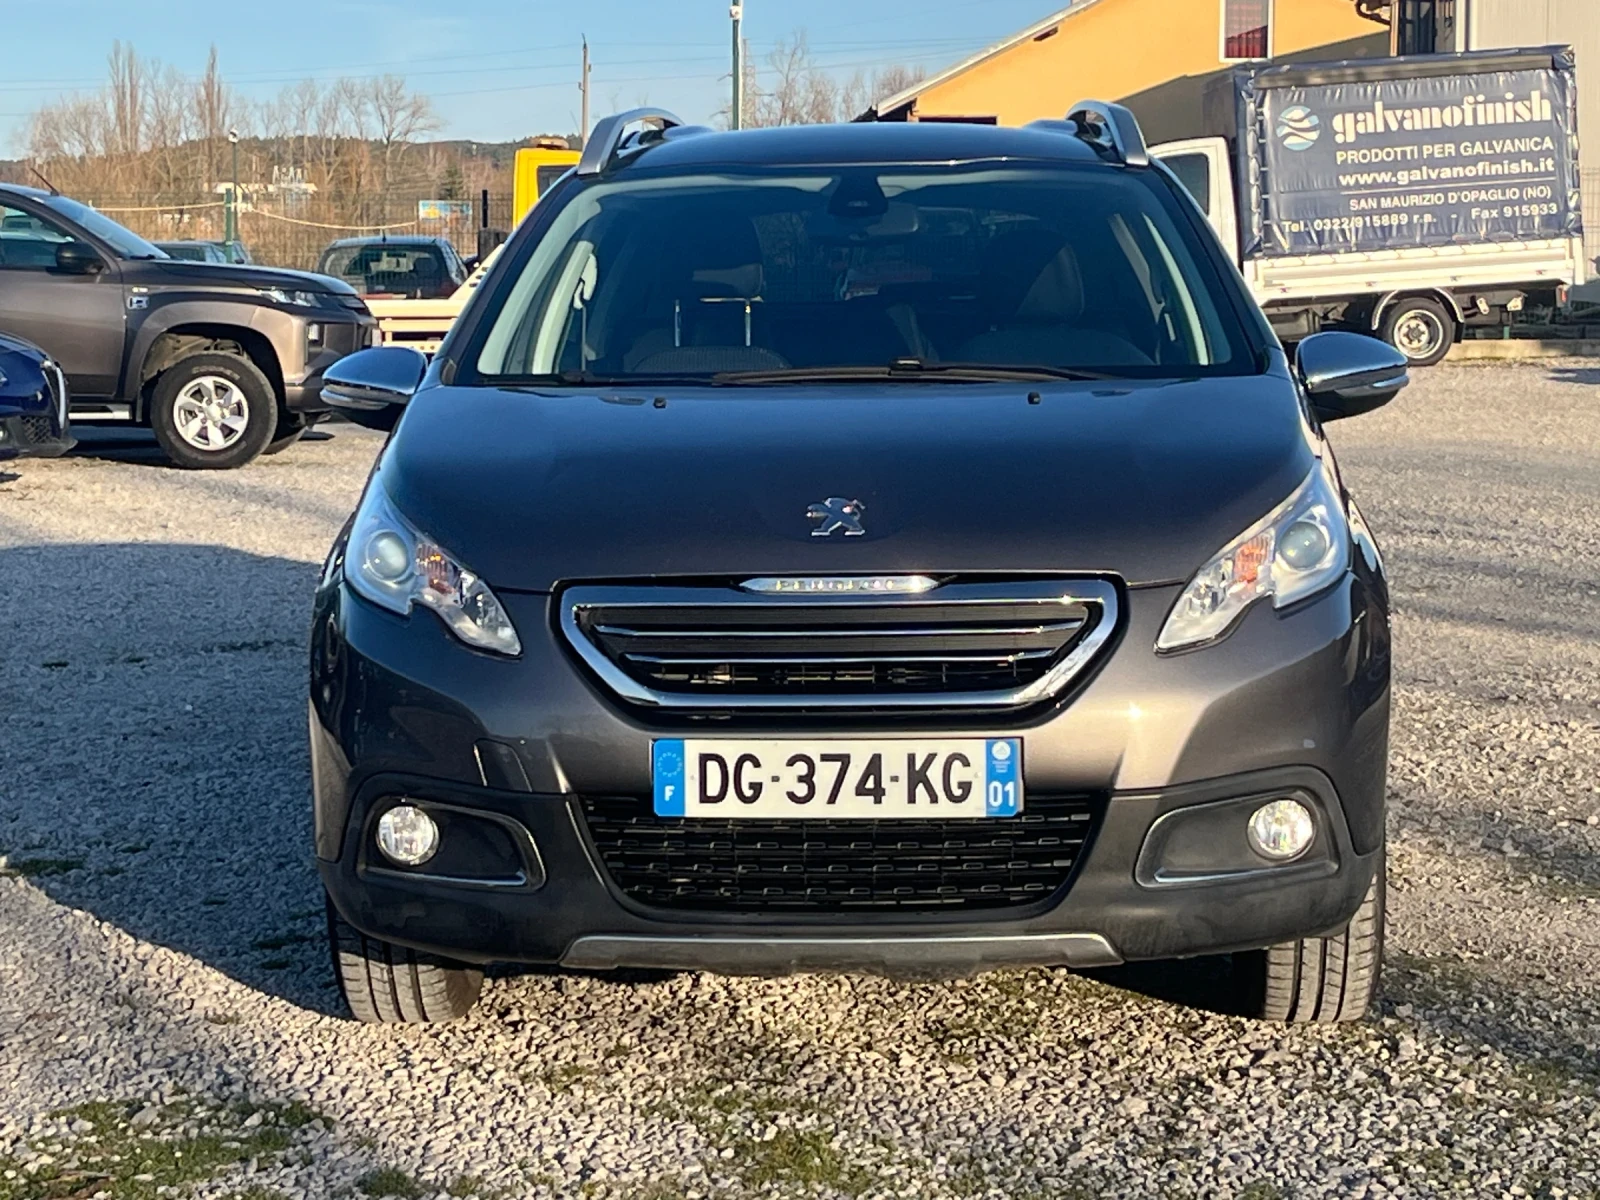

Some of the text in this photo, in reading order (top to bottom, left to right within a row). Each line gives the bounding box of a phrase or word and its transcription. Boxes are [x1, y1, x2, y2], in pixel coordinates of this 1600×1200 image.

[1332, 90, 1552, 143] galvanofinish
[1336, 136, 1554, 164] PRODOTTI PER GALVANICA
[1339, 157, 1555, 186] www.galvanofinish.it
[1350, 186, 1552, 210] SAN MAURIZIO D'OPAGLIO (NO)
[1282, 219, 1309, 232] Tel.
[1313, 213, 1408, 231] 0322/915889
[1471, 207, 1499, 220] Fax
[1503, 202, 1558, 217] 915933
[698, 752, 973, 805] DG-374-KG
[664, 786, 675, 802] F
[988, 780, 1015, 807] 01
